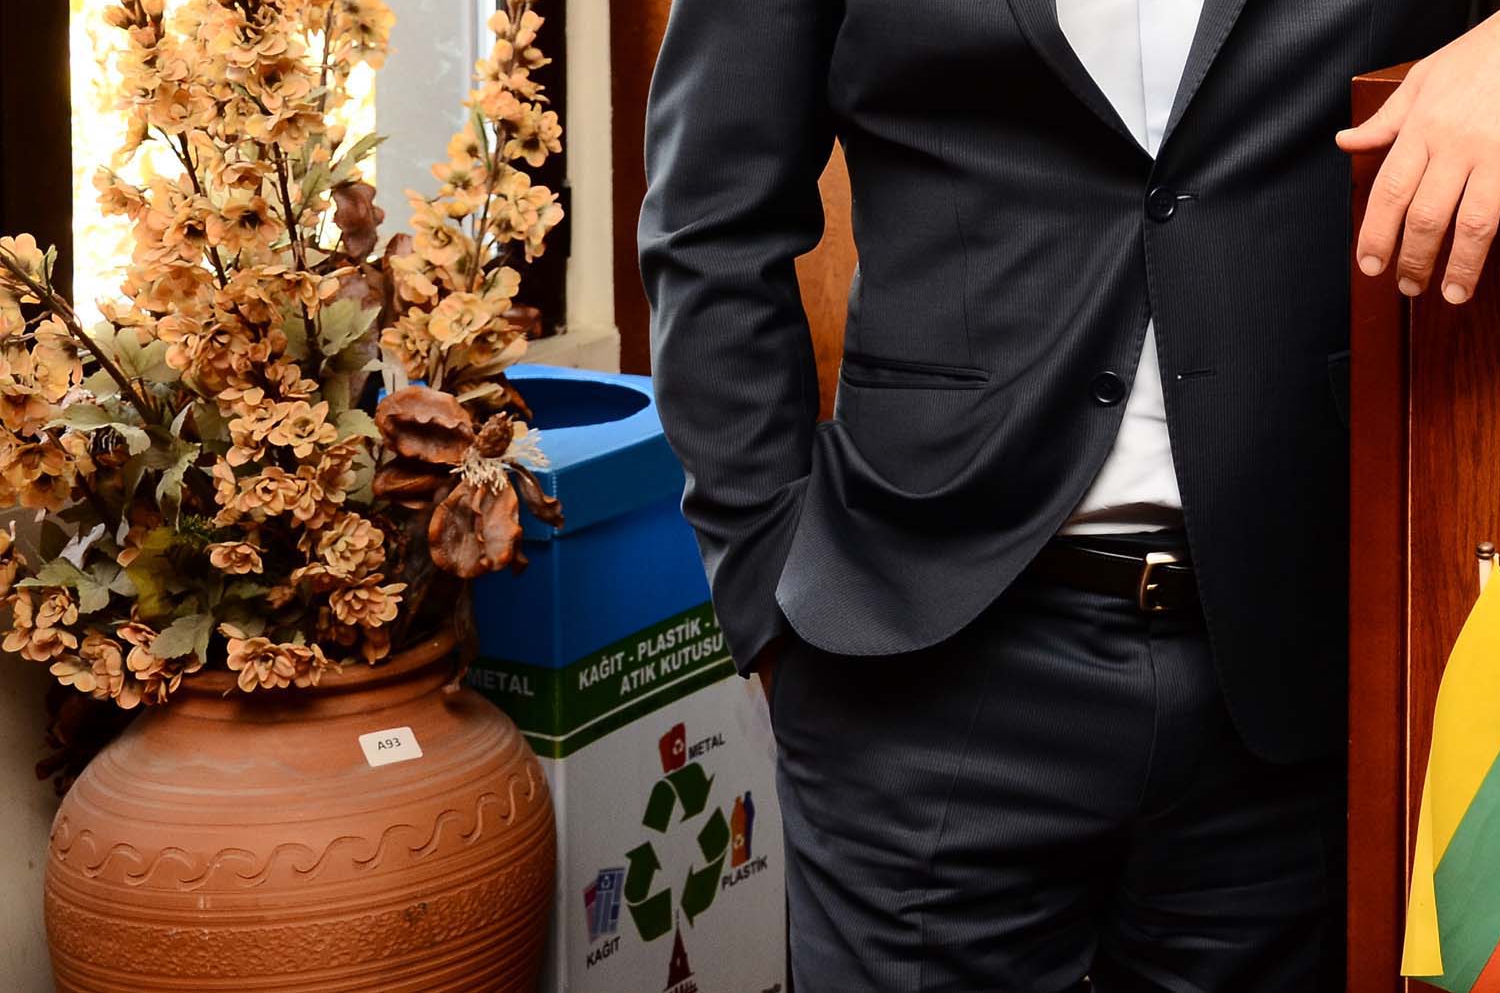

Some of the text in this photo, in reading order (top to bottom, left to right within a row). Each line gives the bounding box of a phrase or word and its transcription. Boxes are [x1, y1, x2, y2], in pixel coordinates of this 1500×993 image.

[578, 651, 625, 691] KAĞIT
[637, 616, 701, 662] PLASTİK
[619, 631, 724, 696] ATIK KUTUSU
[377, 737, 401, 751] A93
[688, 733, 725, 759] METAL
[721, 856, 768, 890] PLASTİK
[586, 936, 620, 969] KAĞIT
